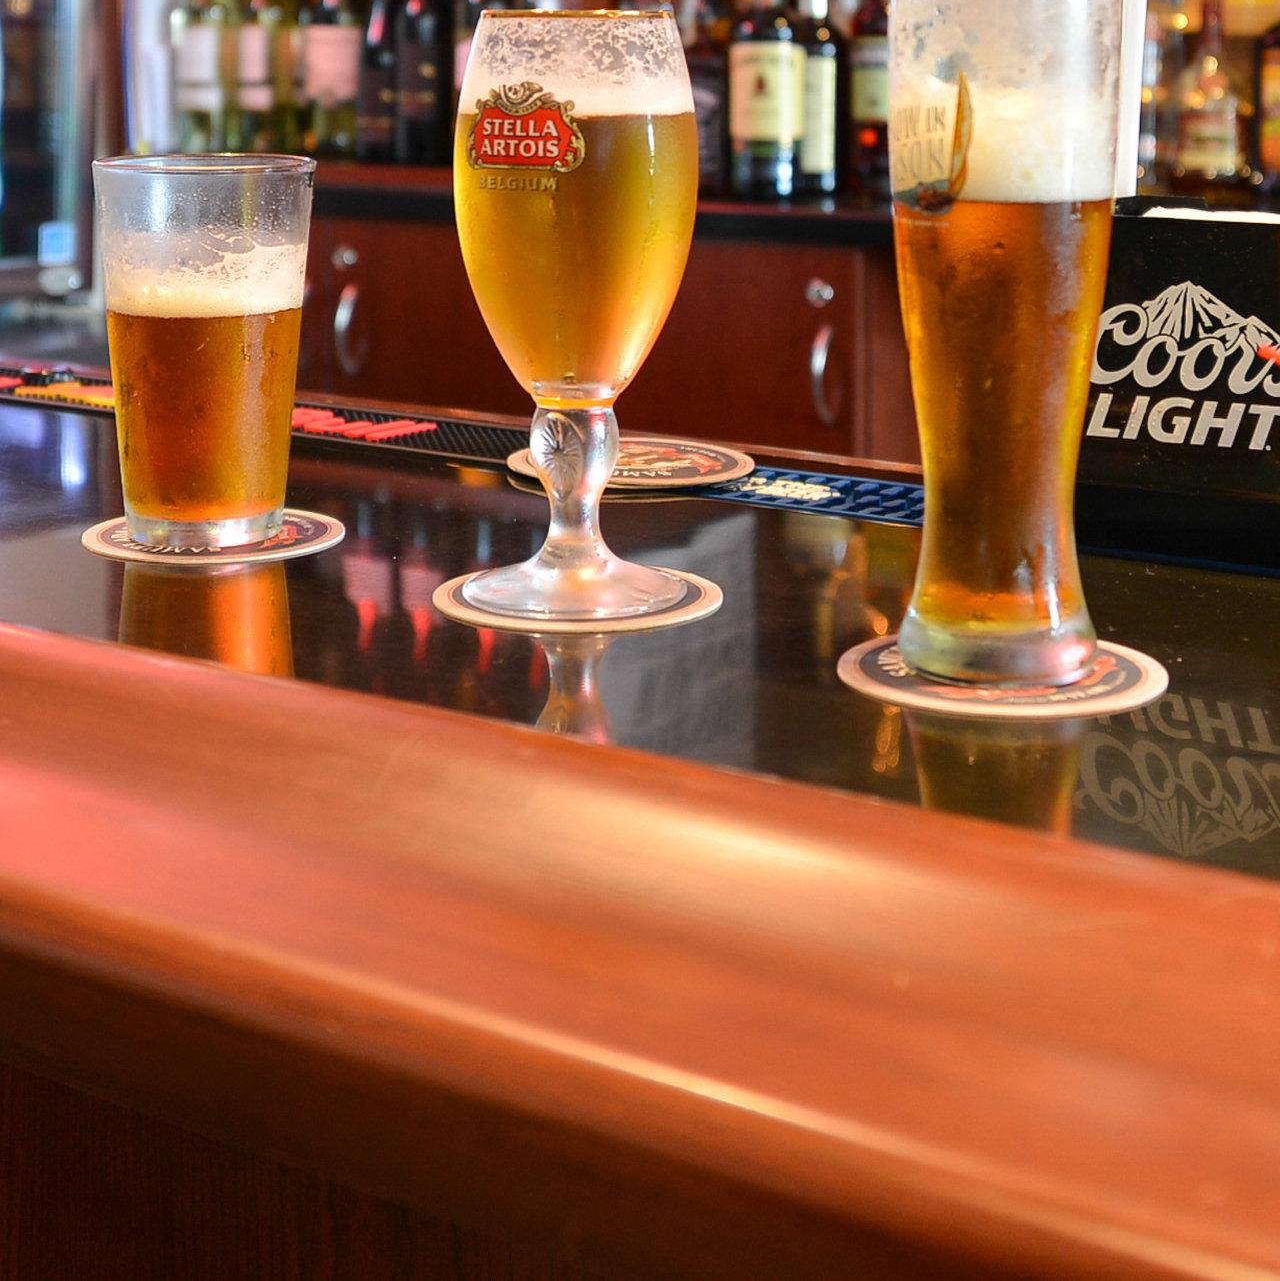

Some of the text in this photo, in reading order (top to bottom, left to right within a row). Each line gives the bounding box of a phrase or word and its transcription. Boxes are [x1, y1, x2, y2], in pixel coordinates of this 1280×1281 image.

[482, 118, 559, 137] STELLA
[480, 138, 561, 158] ARTOIS
[479, 174, 558, 191] BELGIUM
